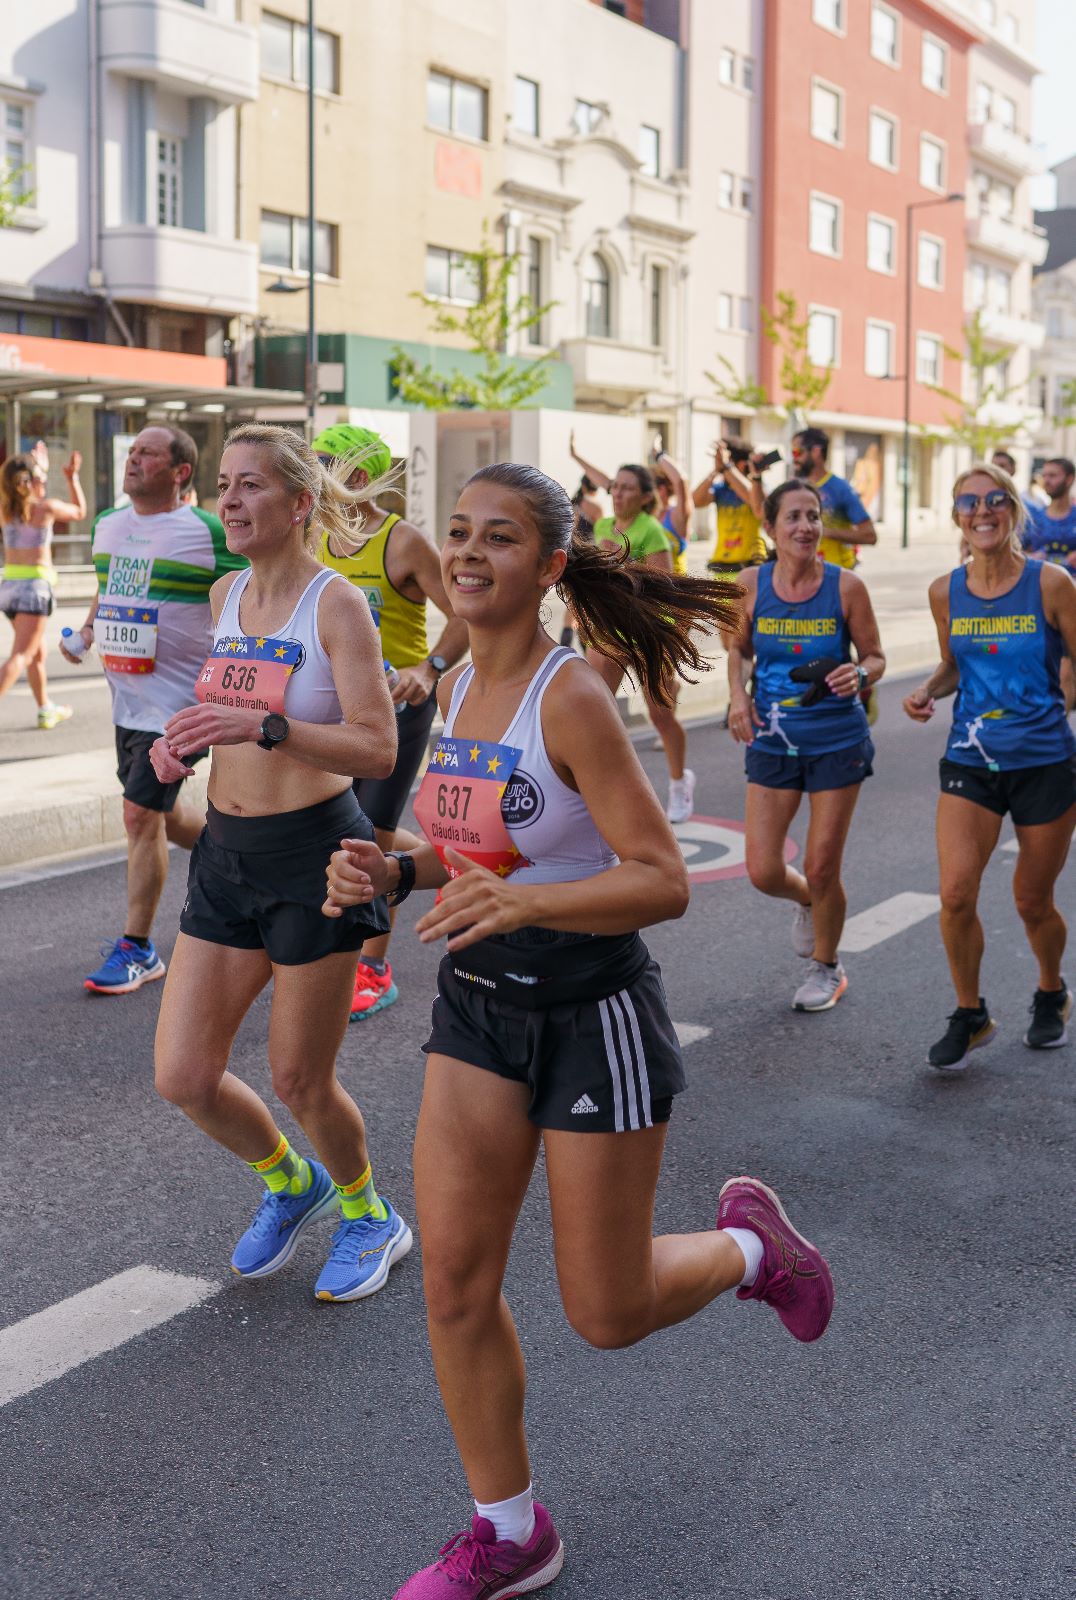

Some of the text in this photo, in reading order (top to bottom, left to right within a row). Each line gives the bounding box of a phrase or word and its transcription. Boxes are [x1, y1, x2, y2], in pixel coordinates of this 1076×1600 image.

[114, 556, 150, 570] TRAN
[109, 583, 144, 598] DADE
[105, 625, 138, 644] 1180
[221, 664, 258, 692] 636
[205, 692, 270, 711] Cláudia Borralho
[504, 783, 530, 797] UN
[437, 783, 473, 822] 637
[501, 797, 534, 812] EJO
[431, 820, 481, 845] Cláudia Dias
[571, 1105, 599, 1115] adidas
